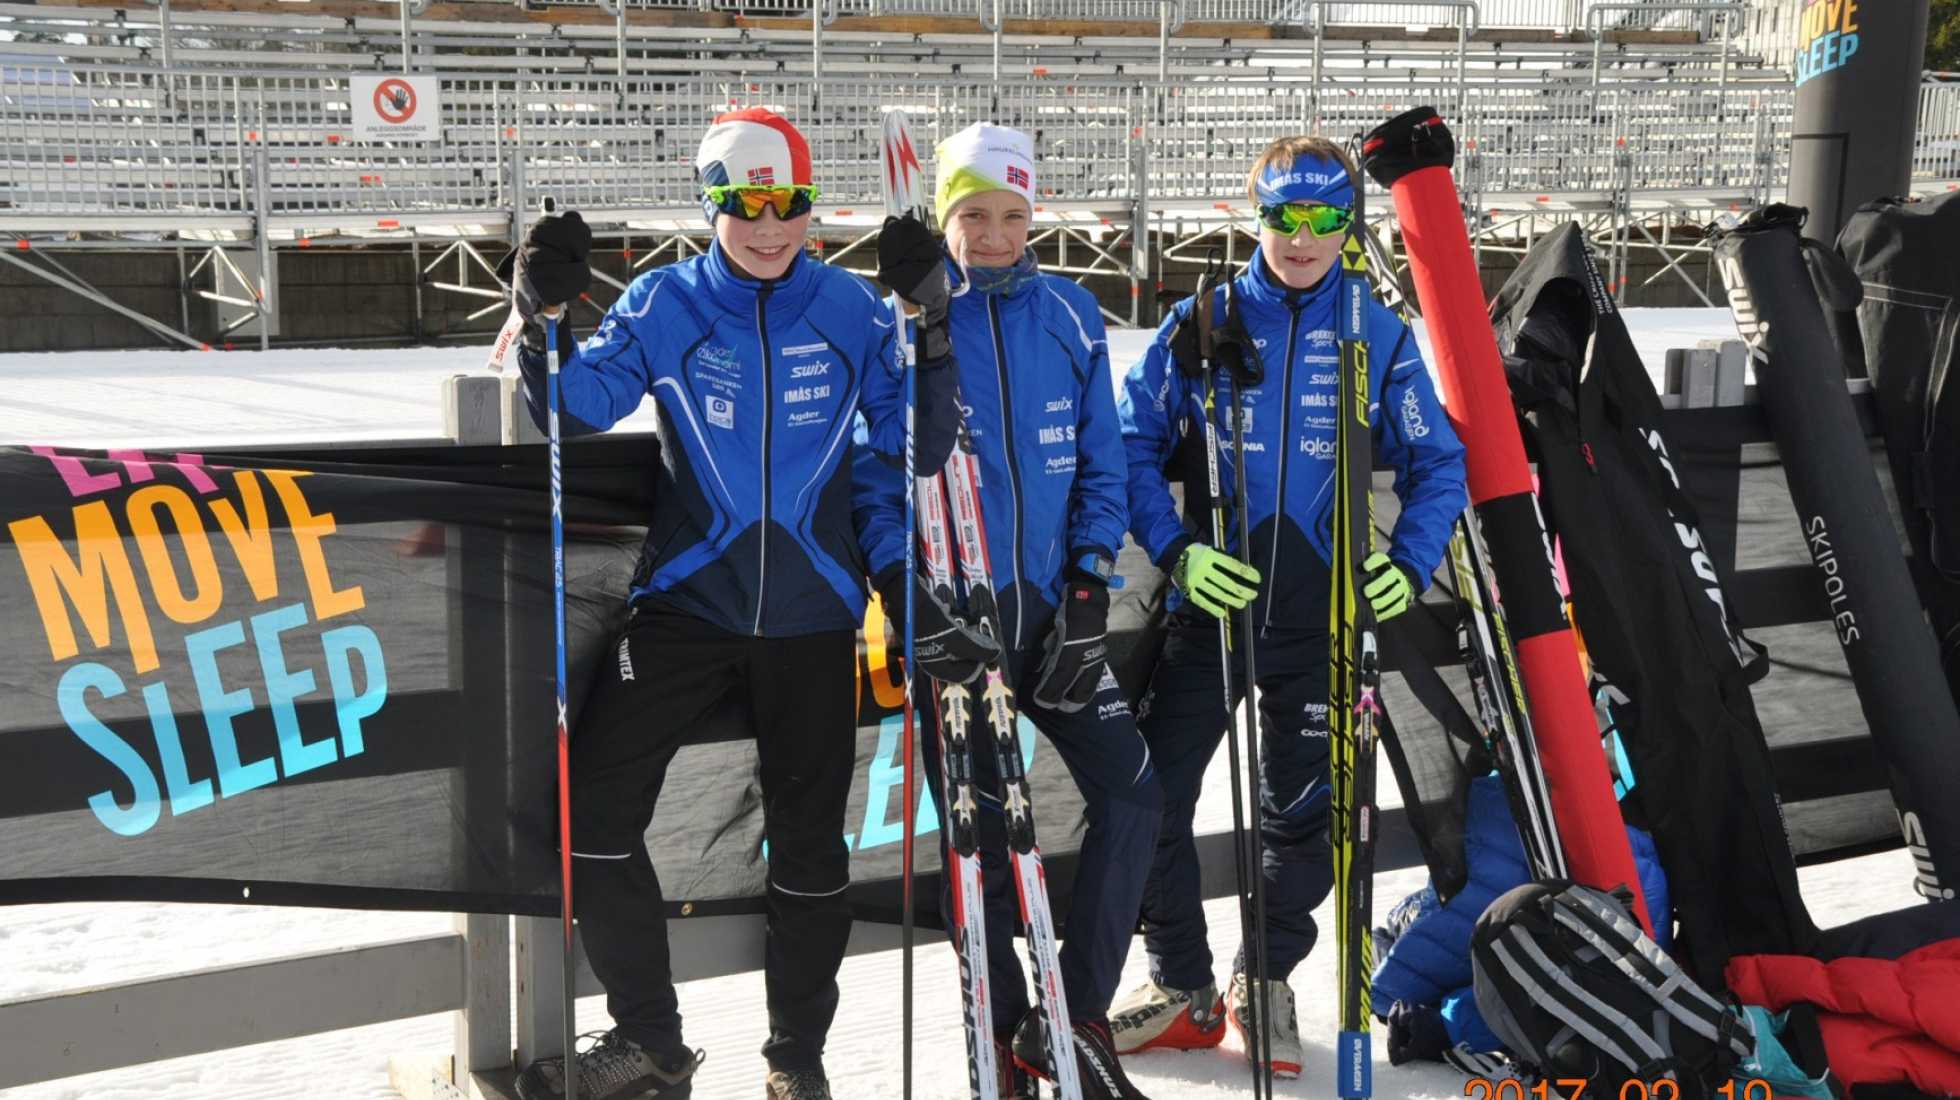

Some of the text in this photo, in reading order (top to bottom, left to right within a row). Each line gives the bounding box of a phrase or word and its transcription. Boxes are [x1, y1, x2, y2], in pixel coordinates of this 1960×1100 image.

[813, 385, 830, 399] SKI
[1221, 441, 1265, 452] SCNIA
[8, 470, 365, 674] MOVE
[1806, 516, 1860, 645] SKIPOLES
[56, 602, 388, 837] SLEEP
